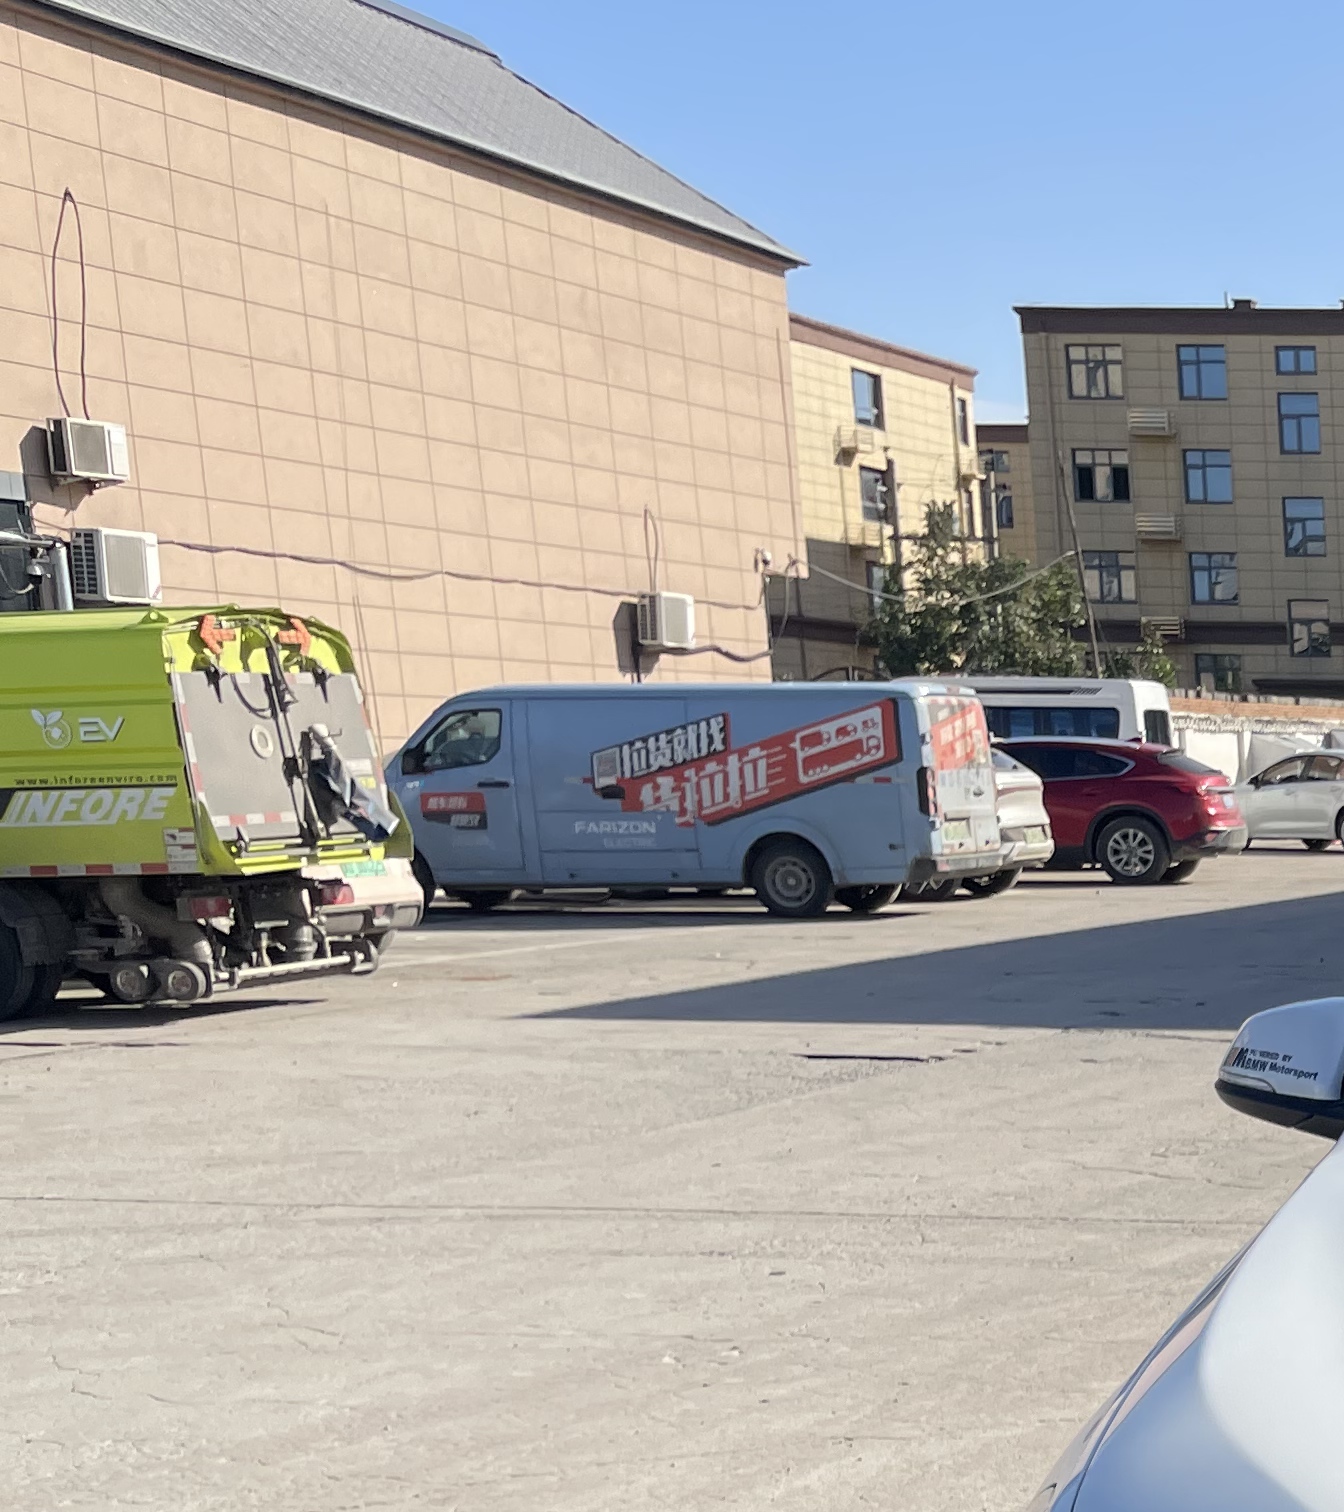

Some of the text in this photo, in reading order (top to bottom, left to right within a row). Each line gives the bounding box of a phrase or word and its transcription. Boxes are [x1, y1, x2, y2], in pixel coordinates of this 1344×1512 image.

[78, 715, 126, 743] EV
[622, 714, 727, 779] 拉货就找
[639, 746, 771, 825] 货拉拉
[8, 787, 178, 826] INFORE
[574, 820, 657, 834] FARIZON
[1245, 1058, 1319, 1081] BMW Motorsport
[1281, 1054, 1294, 1063] BY
